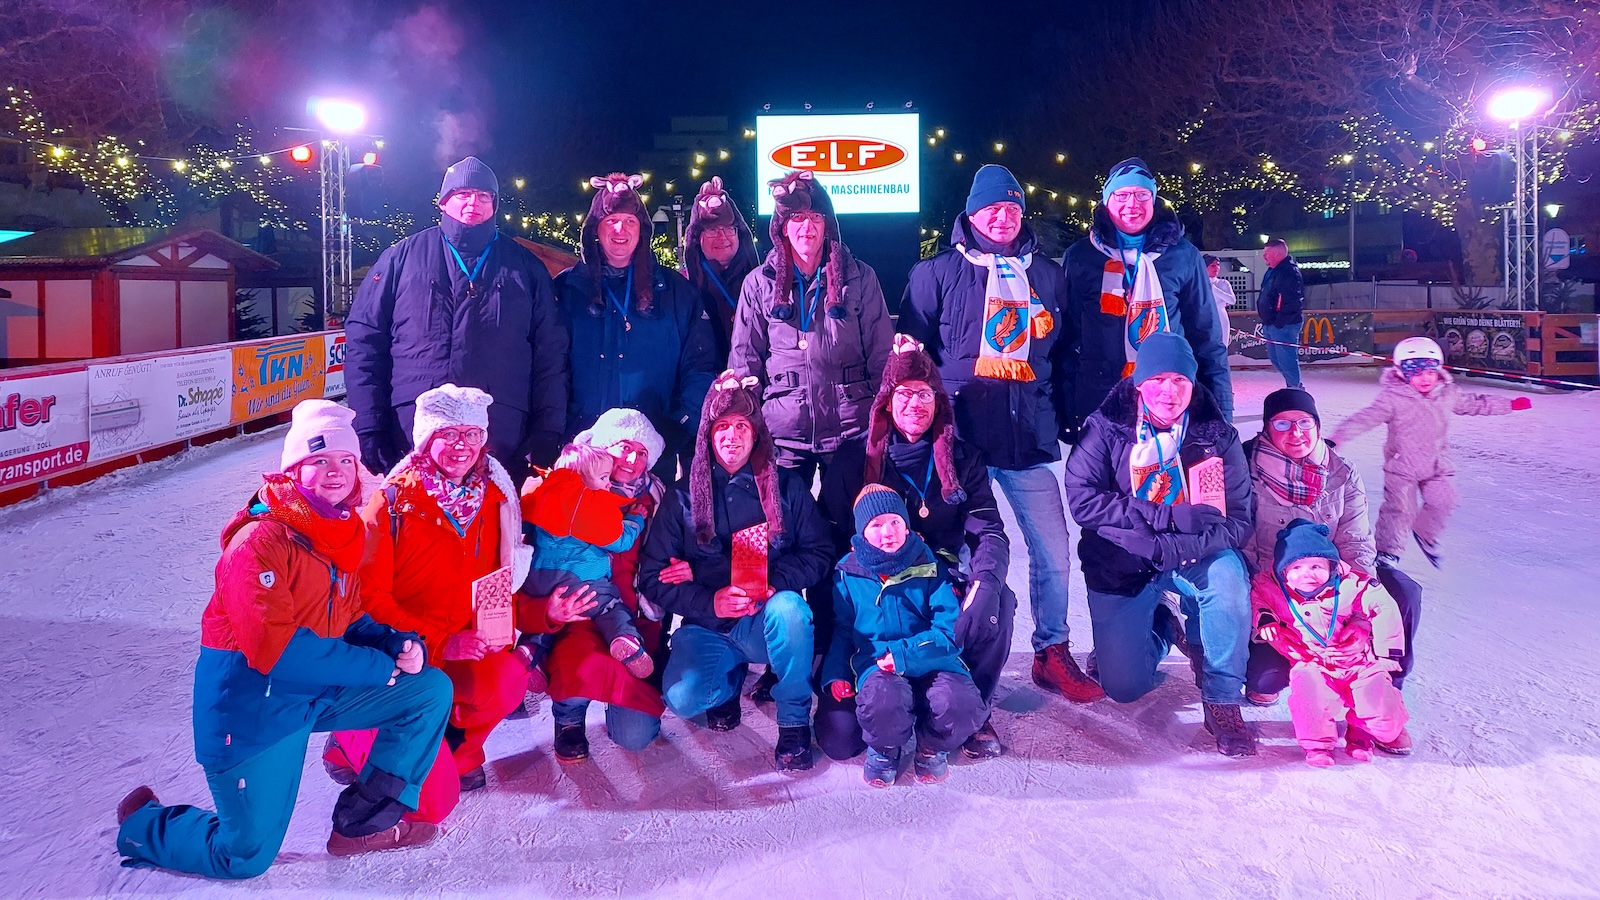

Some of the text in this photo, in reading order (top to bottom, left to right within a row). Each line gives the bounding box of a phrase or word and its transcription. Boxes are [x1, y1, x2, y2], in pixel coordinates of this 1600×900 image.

[831, 183, 910, 195] MASCHINENBAU
[1452, 315, 1466, 325] GRÜN
[1466, 317, 1478, 326] SIND
[1478, 318, 1493, 327] DEINE
[329, 343, 347, 366] SCH
[1298, 344, 1348, 355] euenroth
[94, 363, 152, 379] ANRUF GENÜGT!
[255, 341, 305, 386] TKN
[178, 386, 223, 408] Dr. Schoppe
[247, 398, 264, 416] Wir
[264, 386, 281, 408] sind
[281, 383, 293, 400] die
[0, 445, 30, 457] AGERUNG
[37, 440, 52, 450] ZOLL
[0, 446, 83, 480] ransport.de
